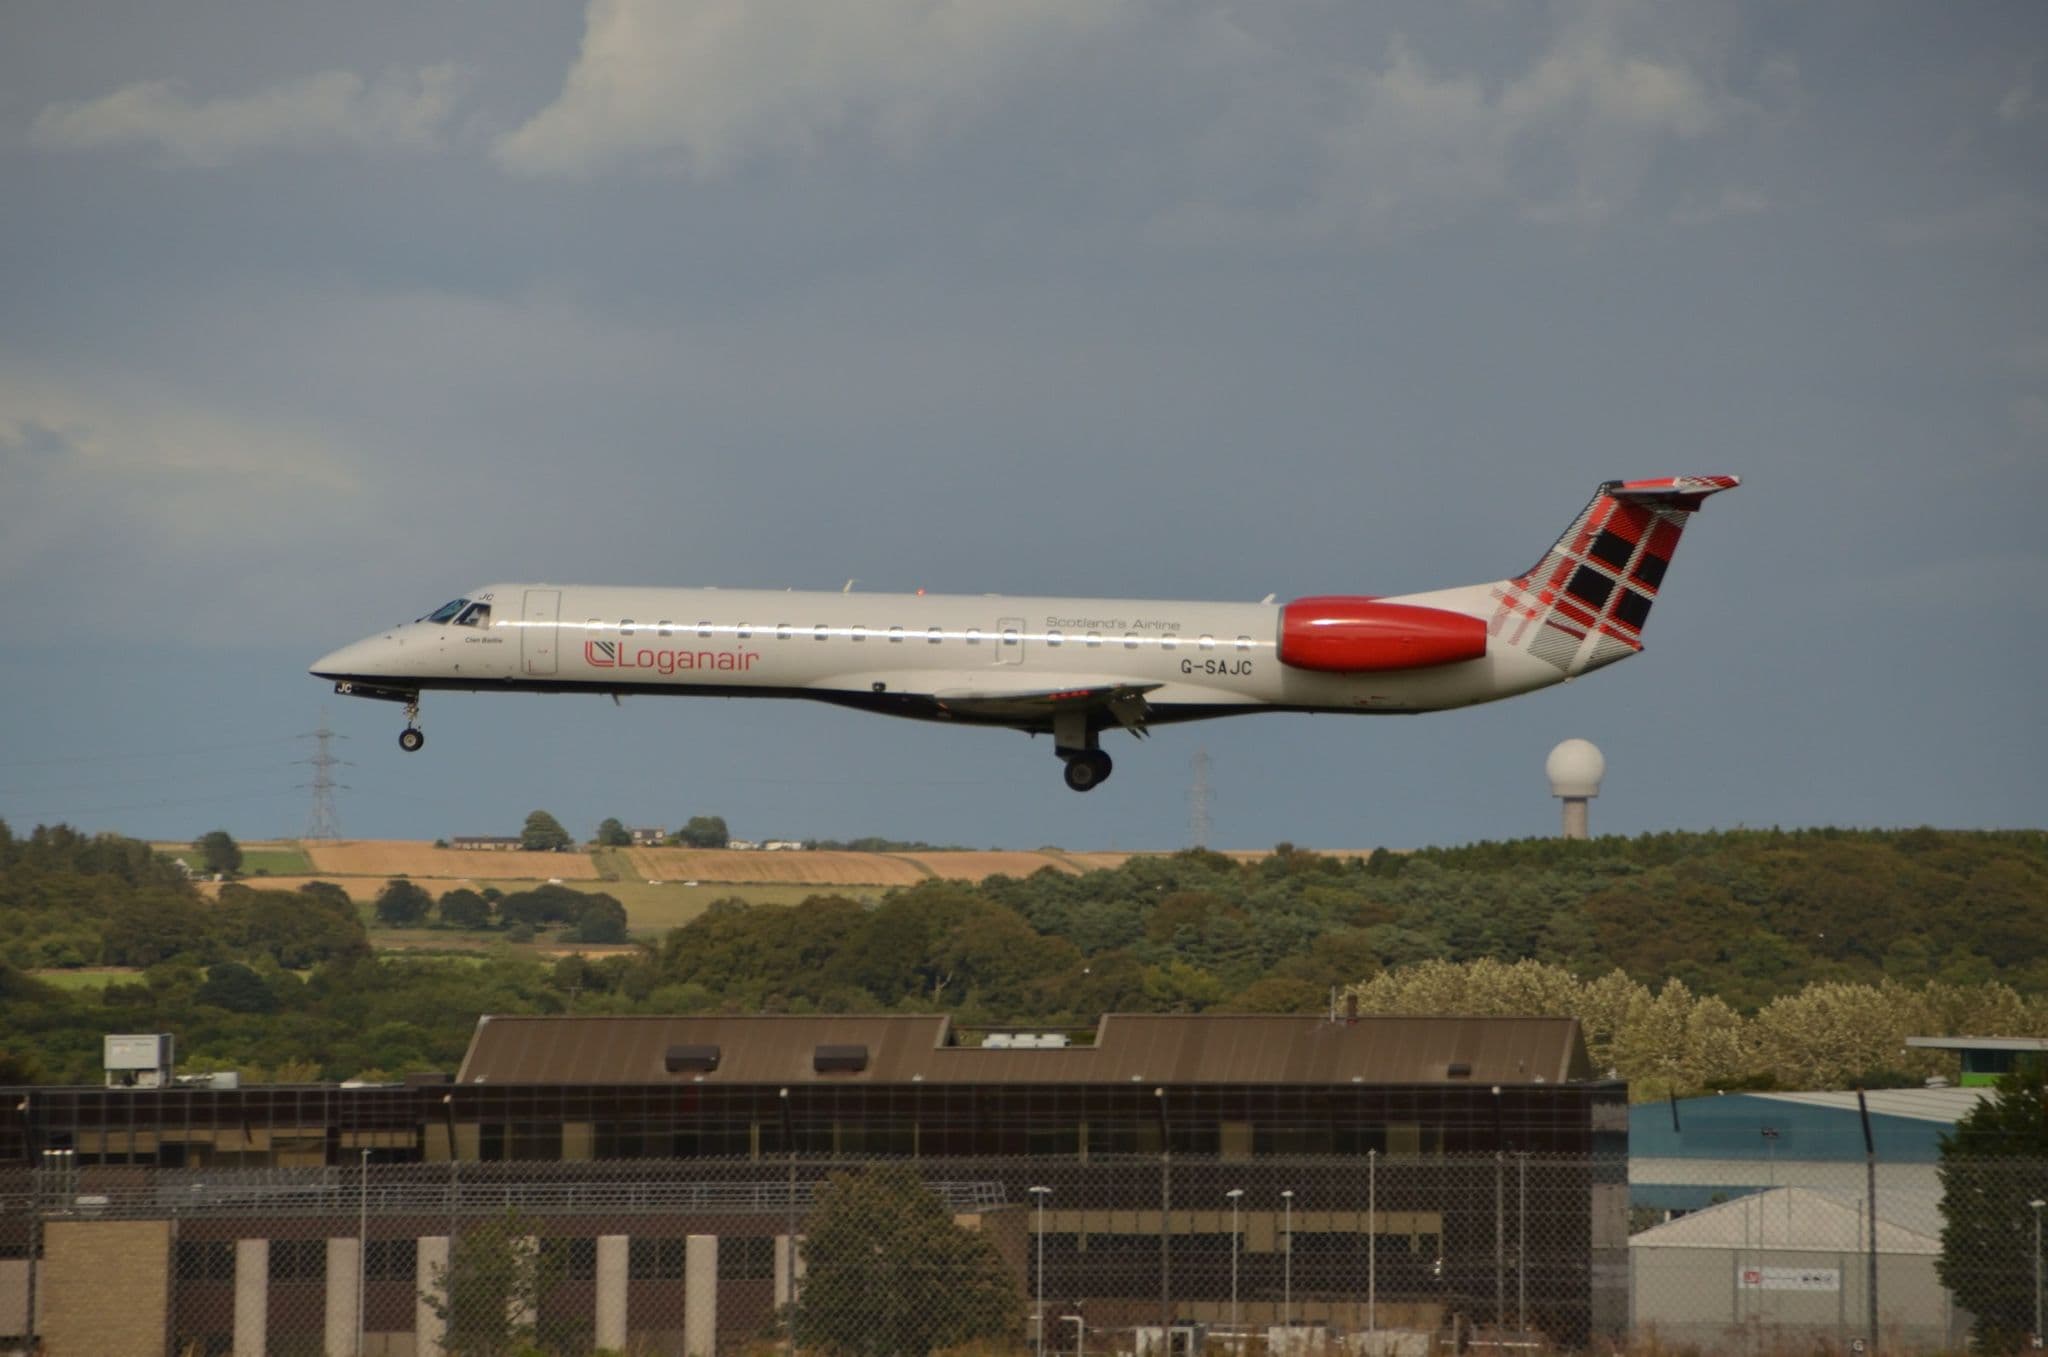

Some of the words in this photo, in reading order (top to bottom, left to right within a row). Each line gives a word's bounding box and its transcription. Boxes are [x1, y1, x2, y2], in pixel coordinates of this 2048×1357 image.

[1045, 616, 1127, 630] Scotland's
[1132, 618, 1181, 632] Airline
[618, 641, 760, 675] Loganair
[1181, 659, 1252, 676] G-SAJC
[337, 682, 353, 694] JC
